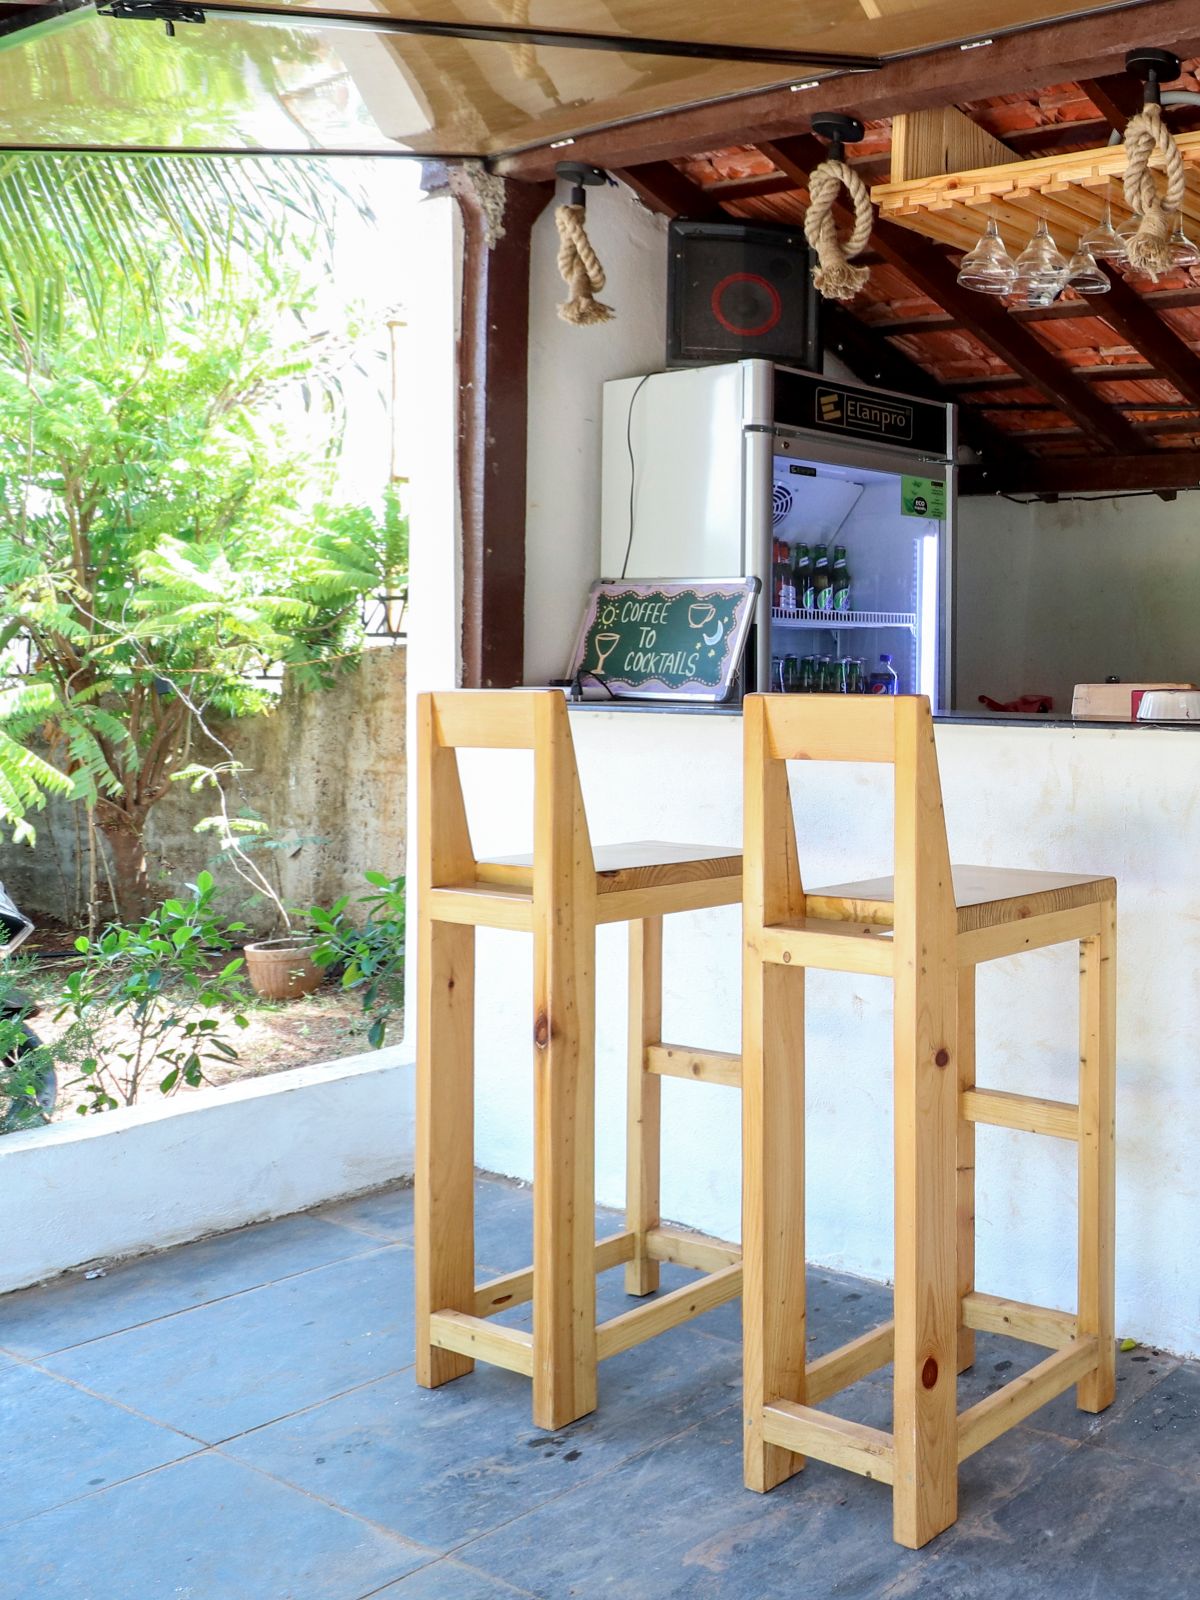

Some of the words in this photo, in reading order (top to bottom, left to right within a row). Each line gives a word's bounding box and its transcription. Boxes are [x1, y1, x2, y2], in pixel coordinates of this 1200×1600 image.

[847, 401, 906, 432] Elanpro
[621, 601, 672, 624] COFFEE
[639, 627, 656, 648] TO
[624, 651, 700, 676] COCKTAILS
